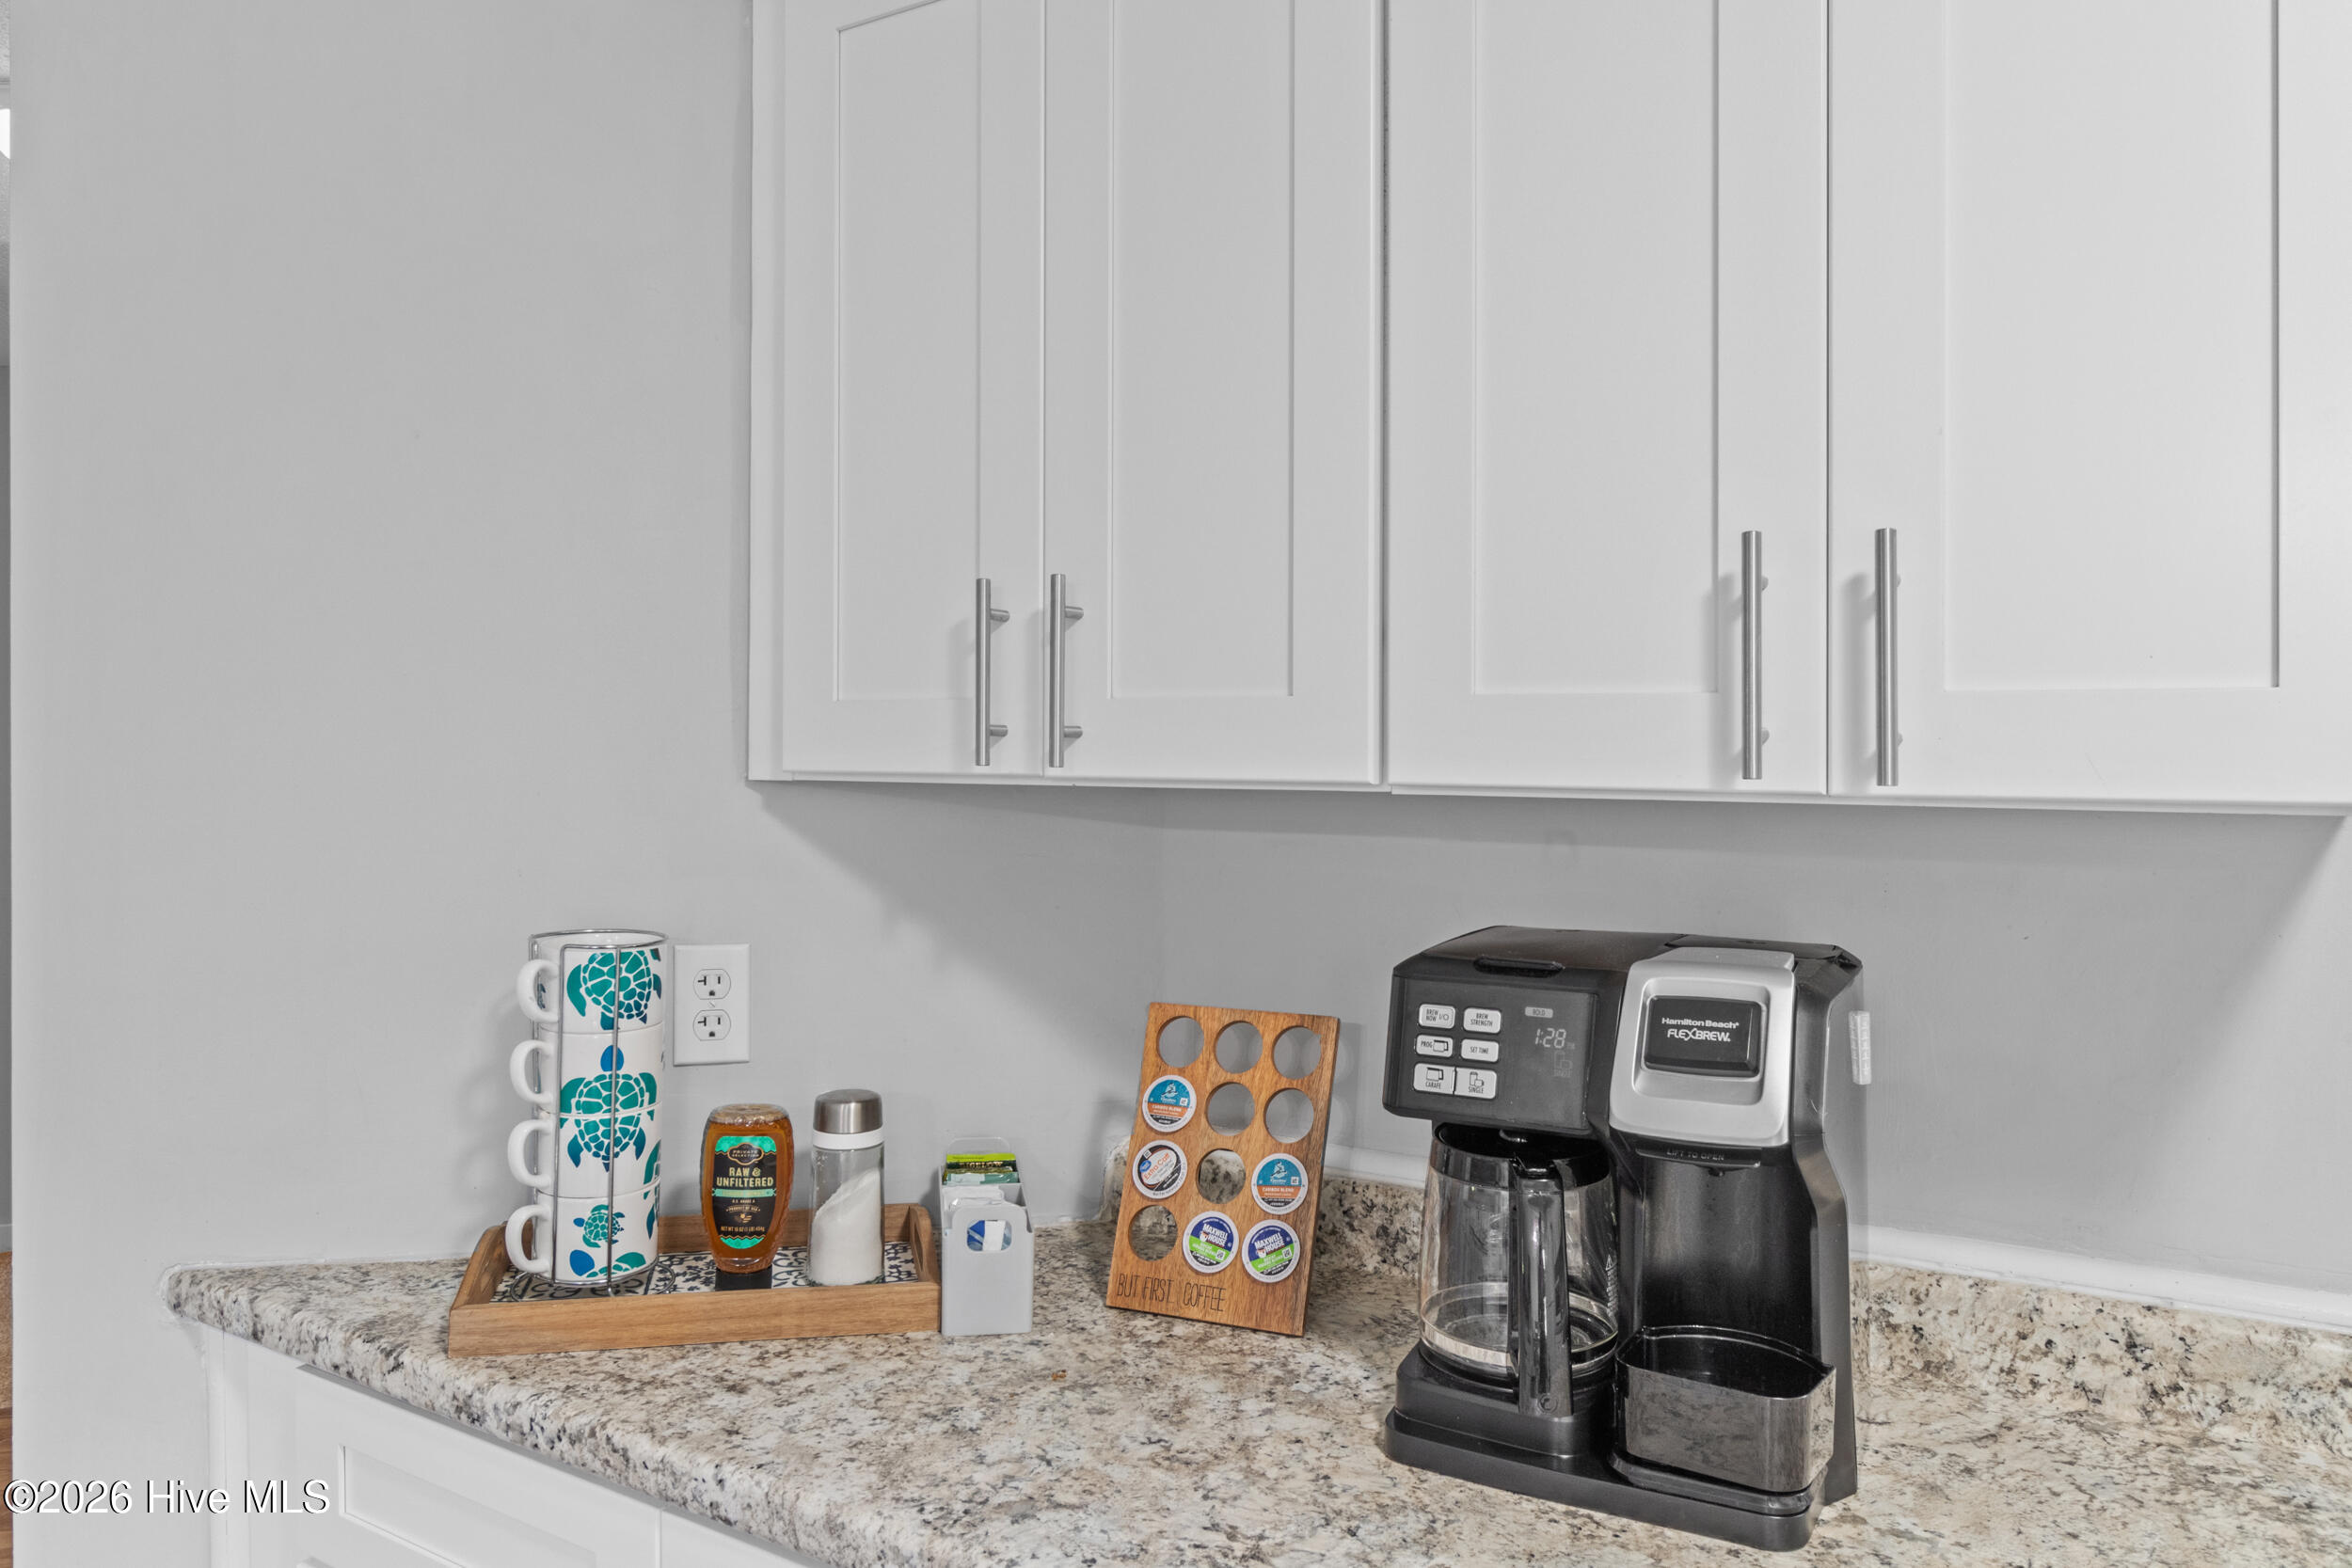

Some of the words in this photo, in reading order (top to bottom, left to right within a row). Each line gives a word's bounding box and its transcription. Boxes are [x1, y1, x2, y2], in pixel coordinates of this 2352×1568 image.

[1476, 1012, 1489, 1021] BREW
[1661, 1017, 1705, 1027] Hamilton
[1470, 1019, 1494, 1028] STRENGTH
[1421, 1039, 1433, 1049] PROG
[1534, 1027, 1567, 1050] 1:28
[1425, 1081, 1441, 1090] CARAFE
[1468, 1085, 1485, 1094] SINGLE
[1701, 1152, 1724, 1161] OPEN
[729, 1166, 750, 1177] RAW
[752, 1166, 761, 1177] &
[716, 1177, 774, 1188] UNFILTERED
[1203, 1223, 1229, 1242] MAXWELL
[1208, 1233, 1226, 1247] HOUSE
[1254, 1232, 1282, 1250] MAXWELL
[1265, 1241, 1285, 1253] HOUSE
[1117, 1273, 1140, 1298] BUT
[1142, 1275, 1175, 1304] FIRST
[1183, 1281, 1227, 1312] COFFEE
